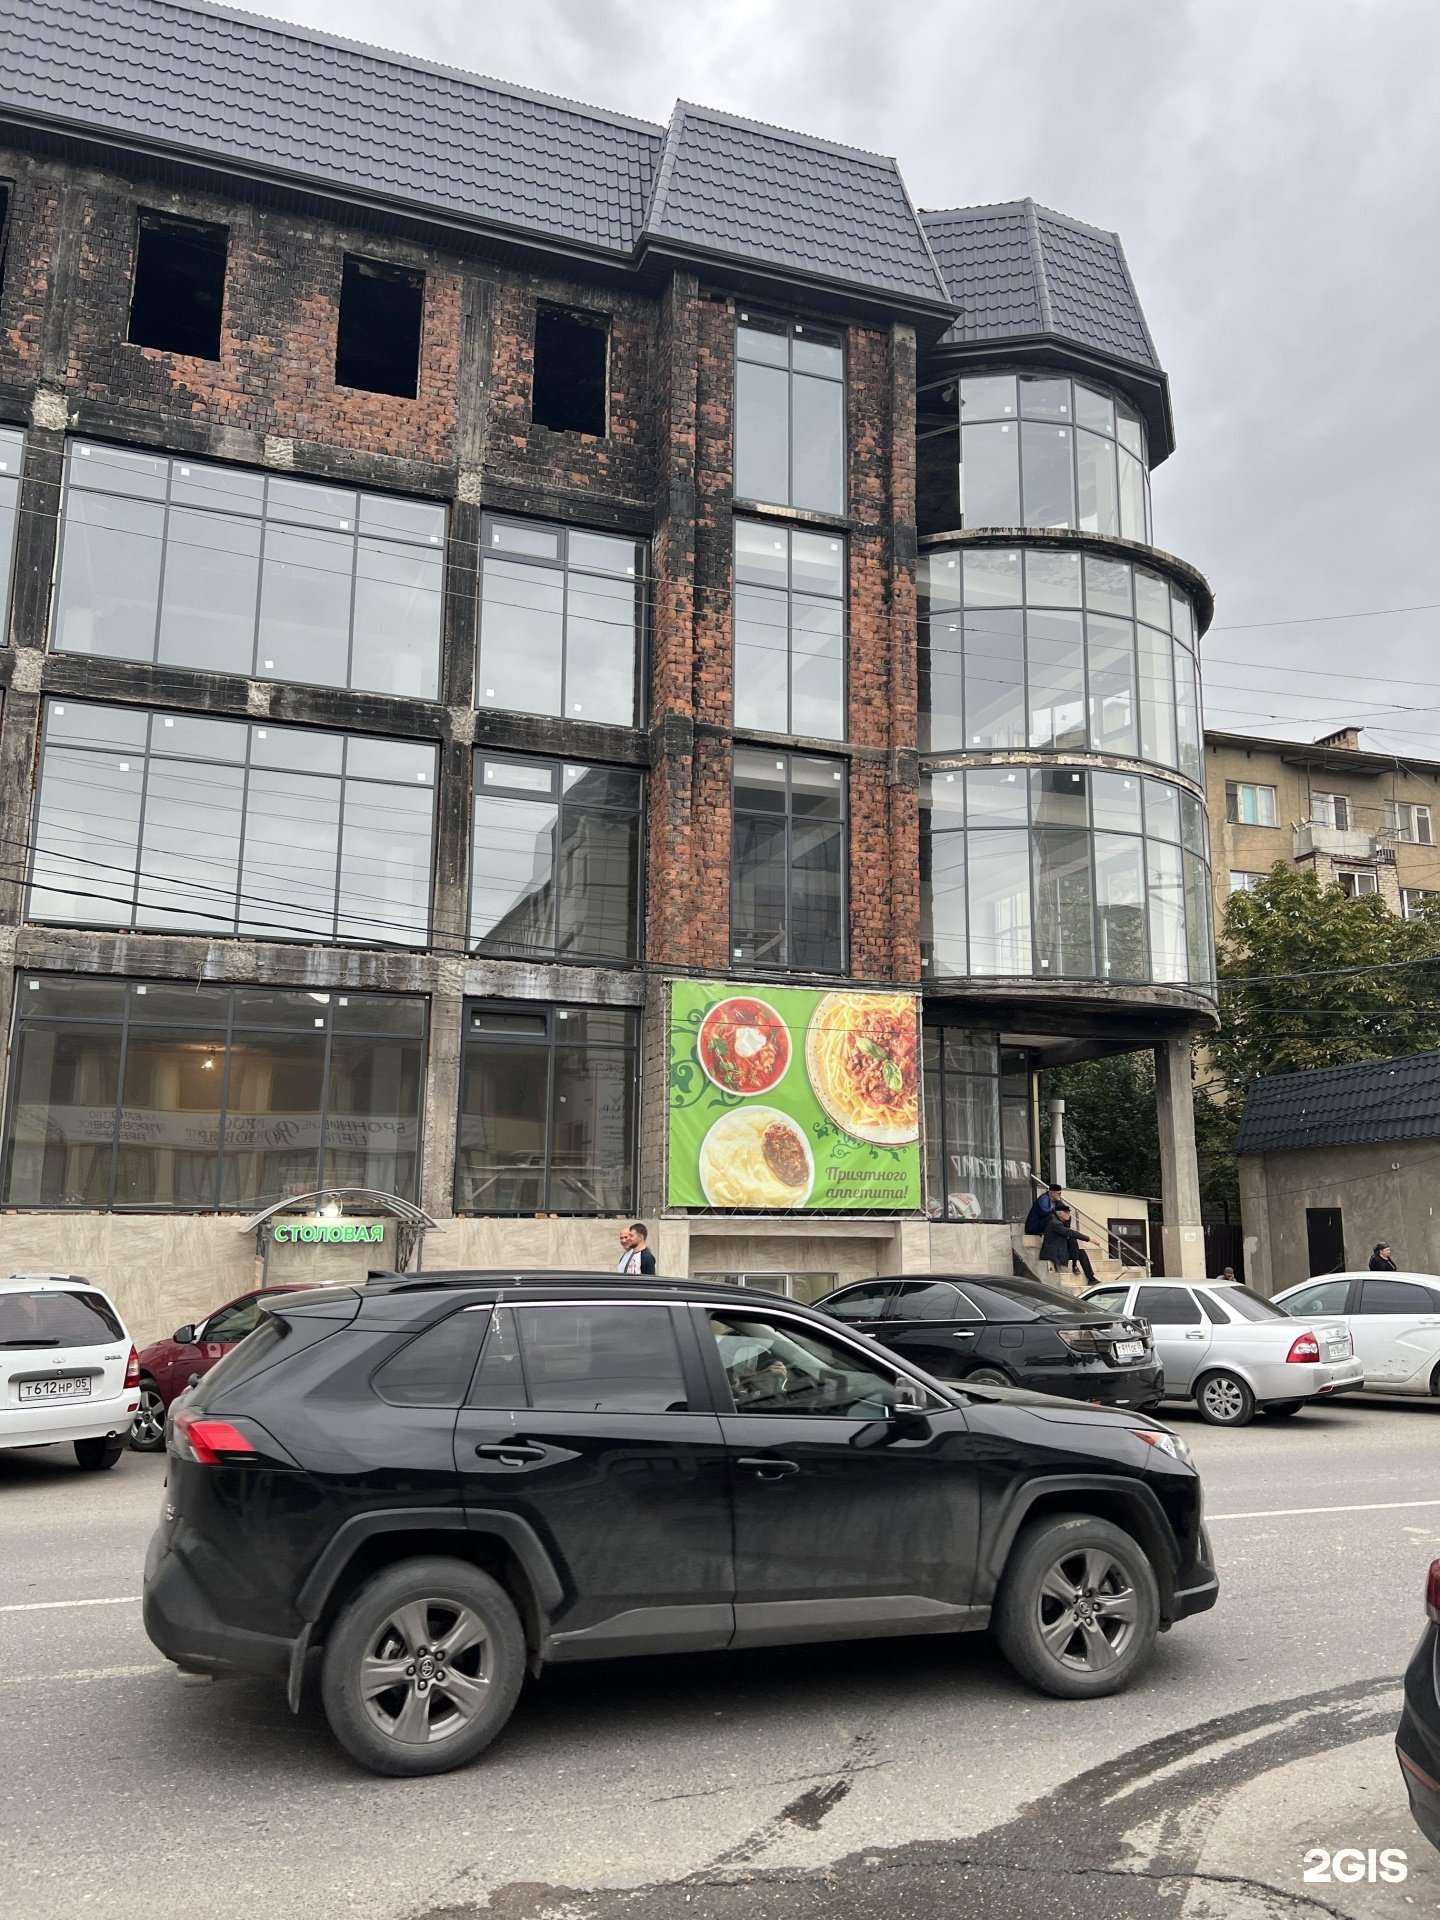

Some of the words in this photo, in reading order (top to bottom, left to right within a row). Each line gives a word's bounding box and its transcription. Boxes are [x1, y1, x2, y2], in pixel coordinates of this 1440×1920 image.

[825, 1167, 907, 1184] Приятного
[826, 1186, 909, 1199] аппетита!
[274, 1224, 384, 1242] СТОЛОВАЯ
